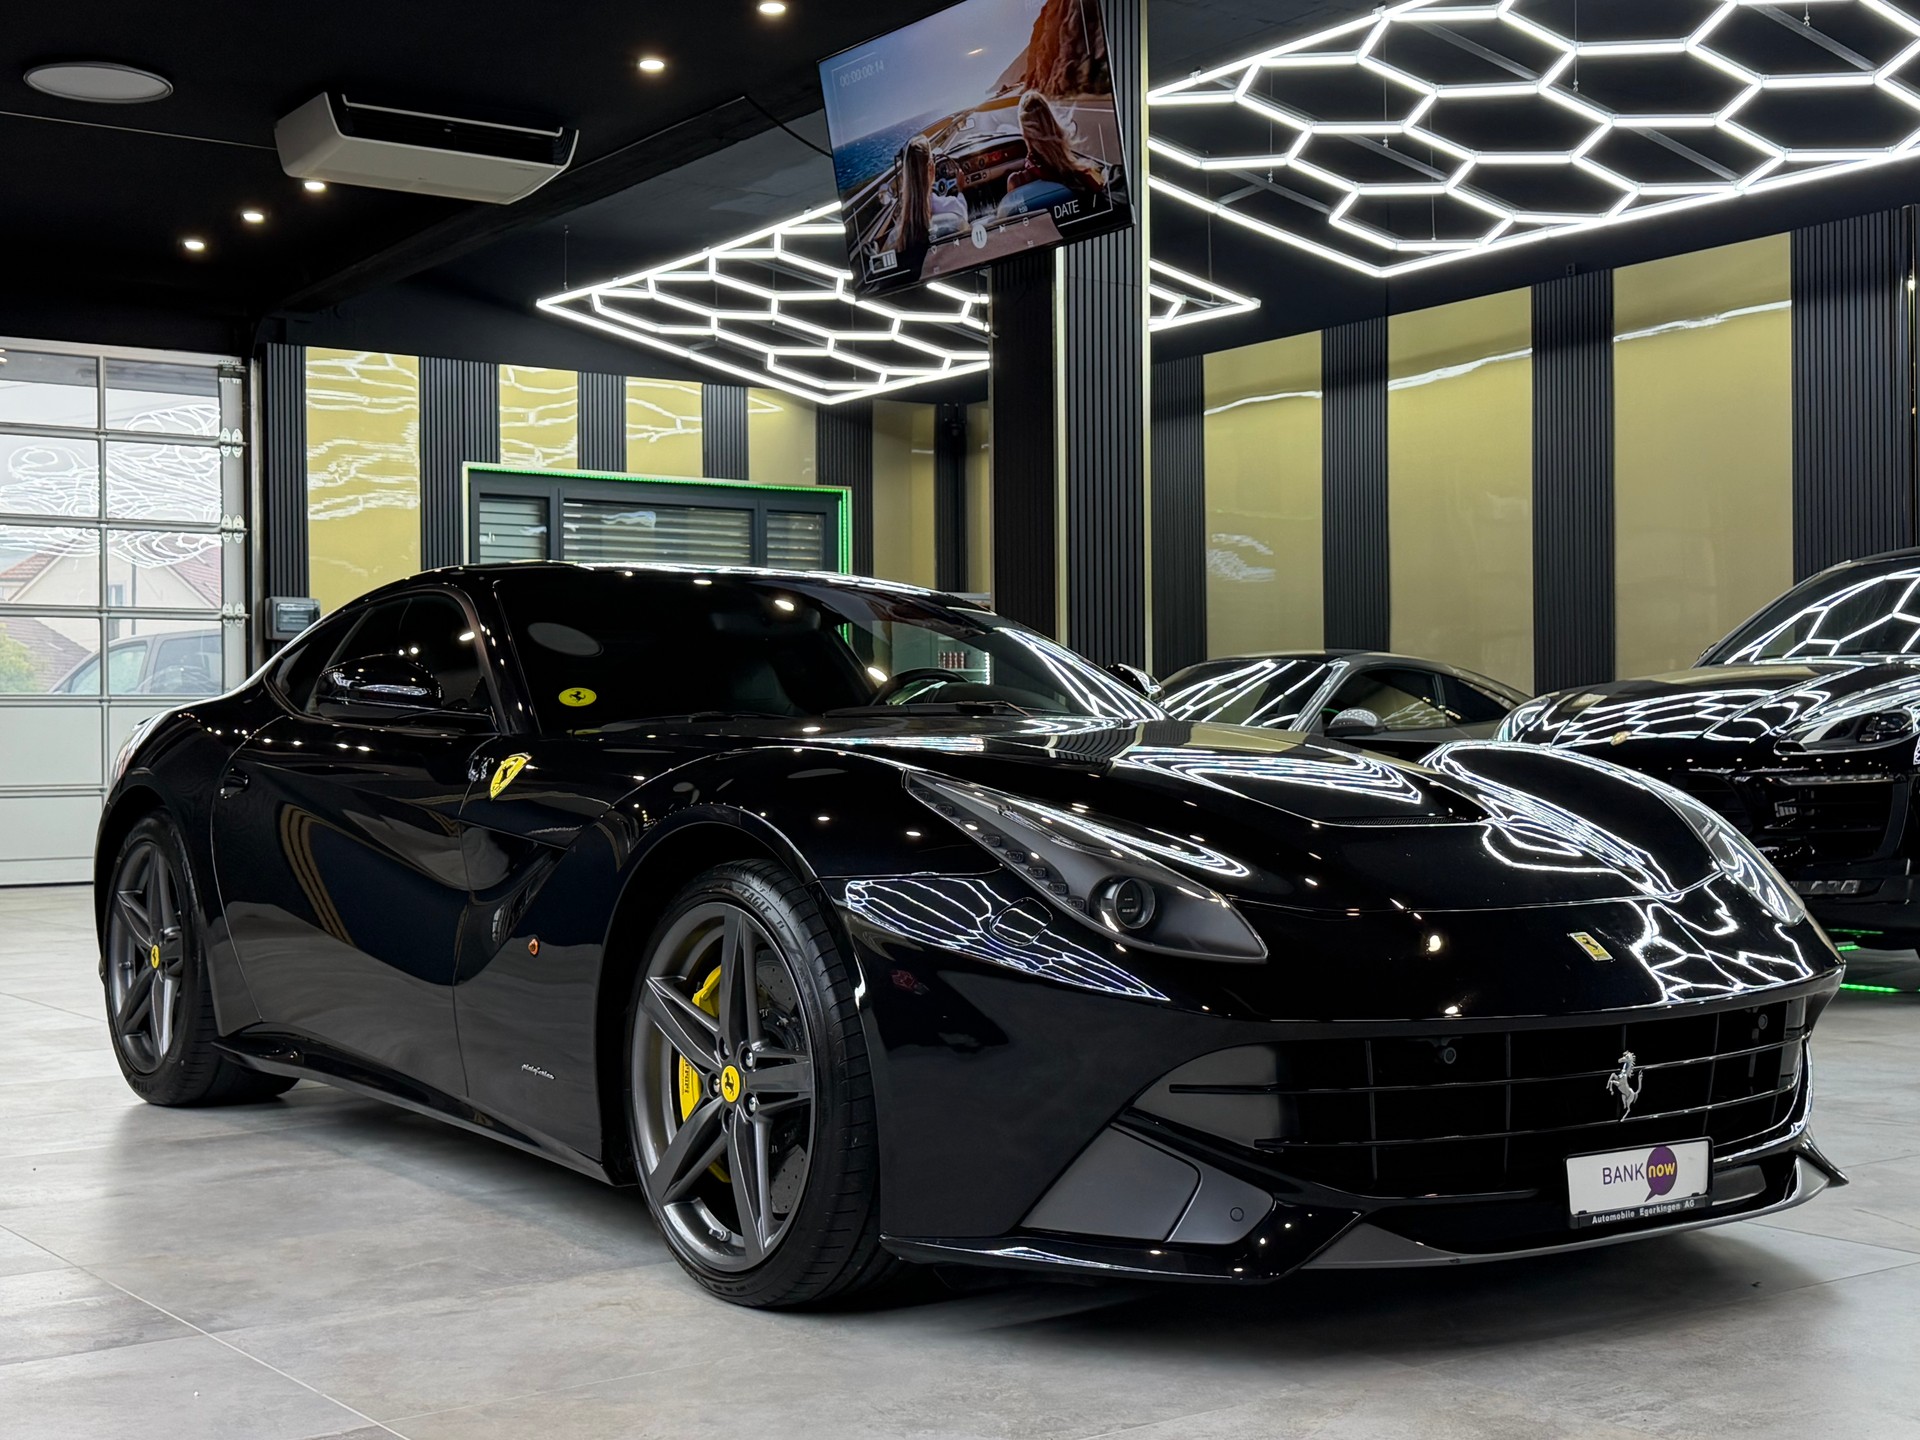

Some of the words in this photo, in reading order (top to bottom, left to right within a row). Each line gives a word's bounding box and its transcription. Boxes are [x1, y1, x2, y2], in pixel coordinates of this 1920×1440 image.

[1053, 200, 1080, 219] DATE
[739, 887, 772, 916] EAGLE
[1602, 1163, 1645, 1185] BANK
[1648, 1162, 1676, 1178] now
[1591, 1211, 1635, 1225] Automobile
[1639, 1202, 1681, 1217] Egerkingen
[1684, 1199, 1695, 1208] AG
